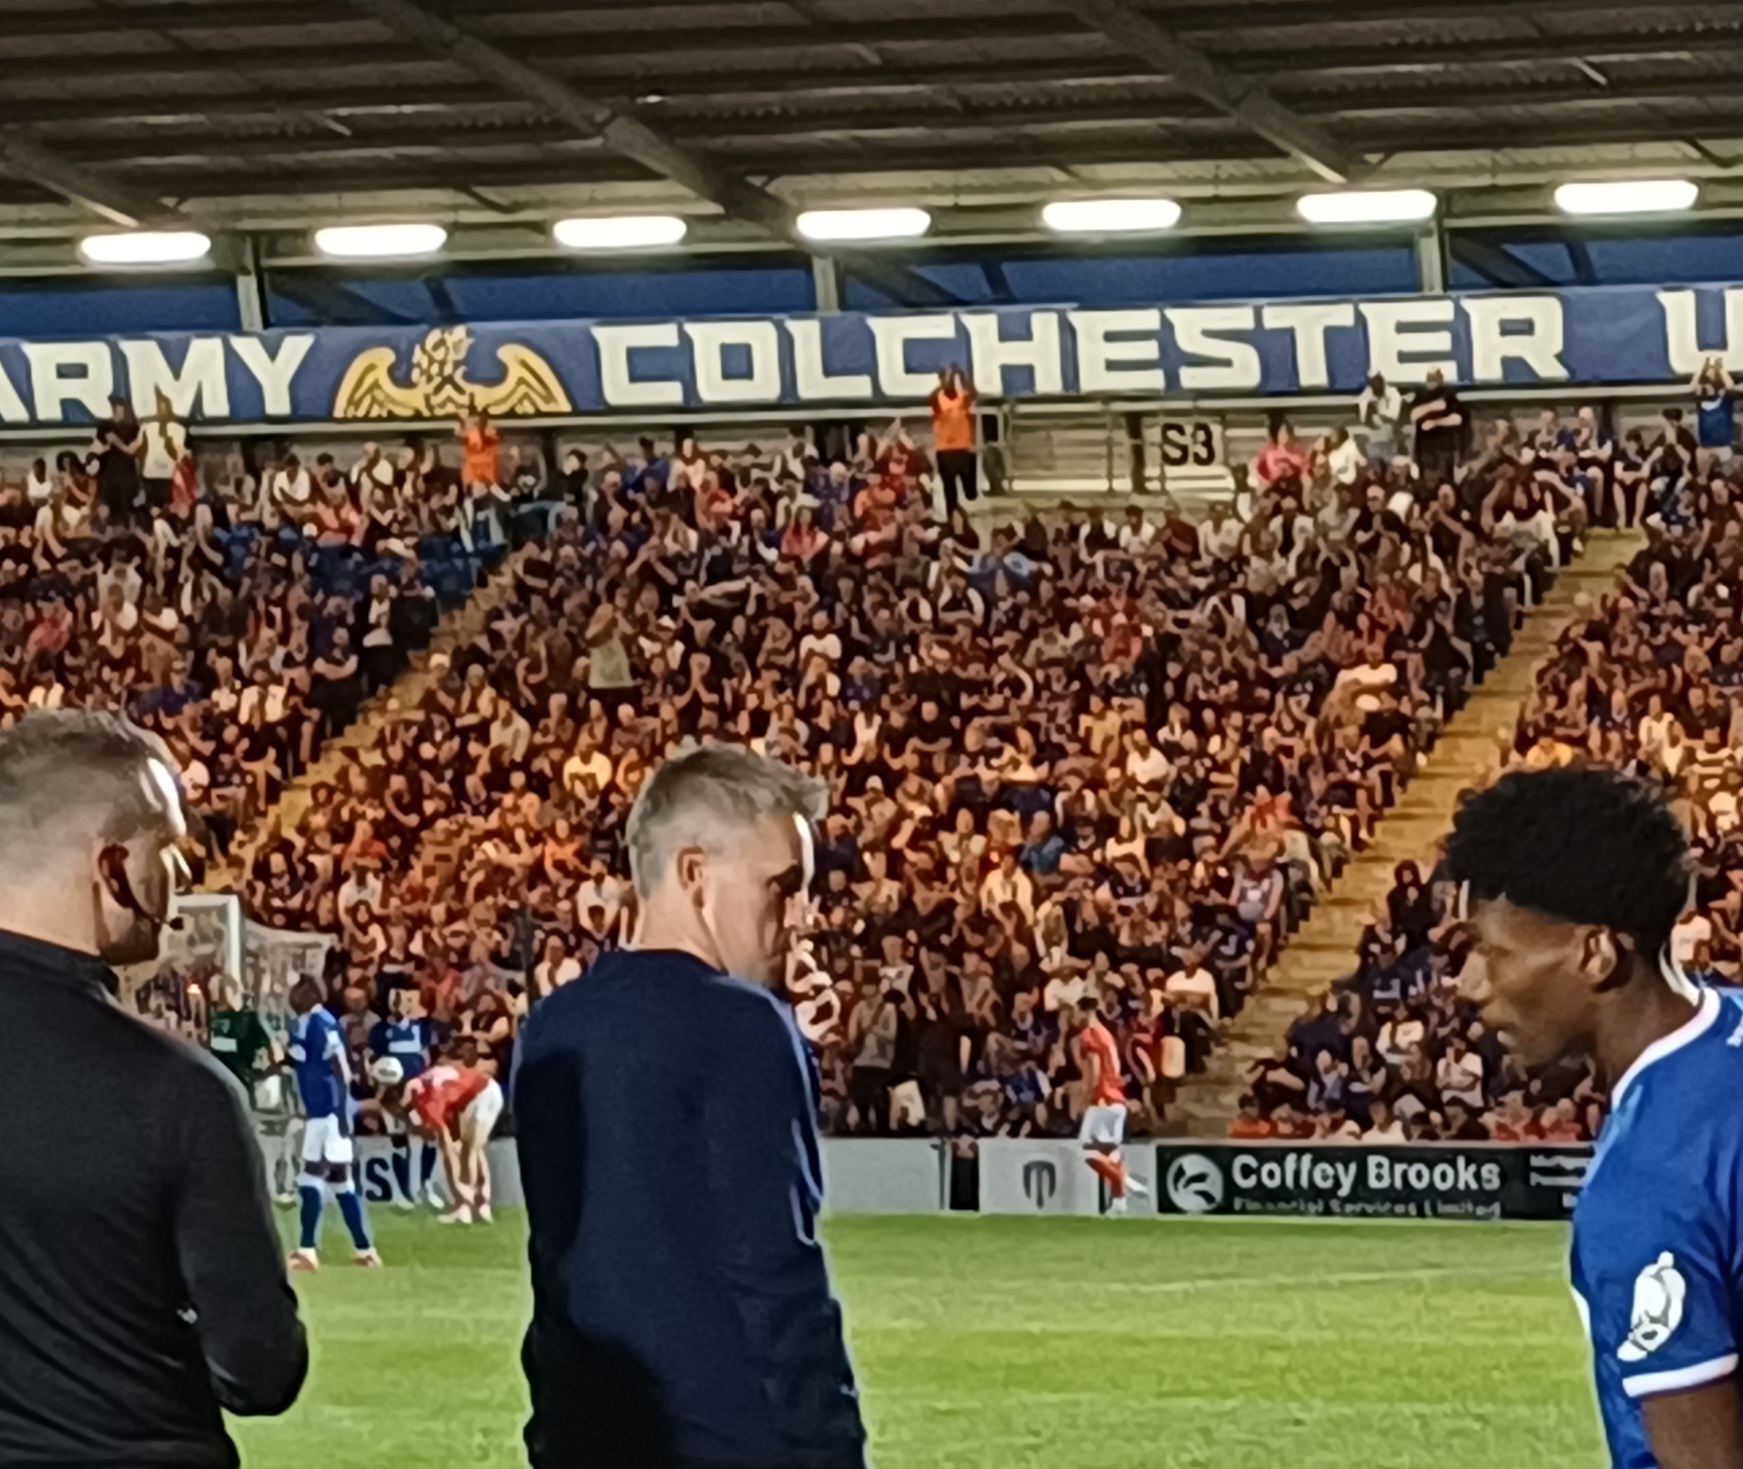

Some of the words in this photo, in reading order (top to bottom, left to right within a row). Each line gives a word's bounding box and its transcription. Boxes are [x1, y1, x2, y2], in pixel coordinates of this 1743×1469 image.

[591, 293, 1570, 407] COLCHESTER
[1162, 422, 1215, 466] S3
[1232, 1152, 1357, 1197] Coffey
[1366, 1155, 1500, 1190] Brooks
